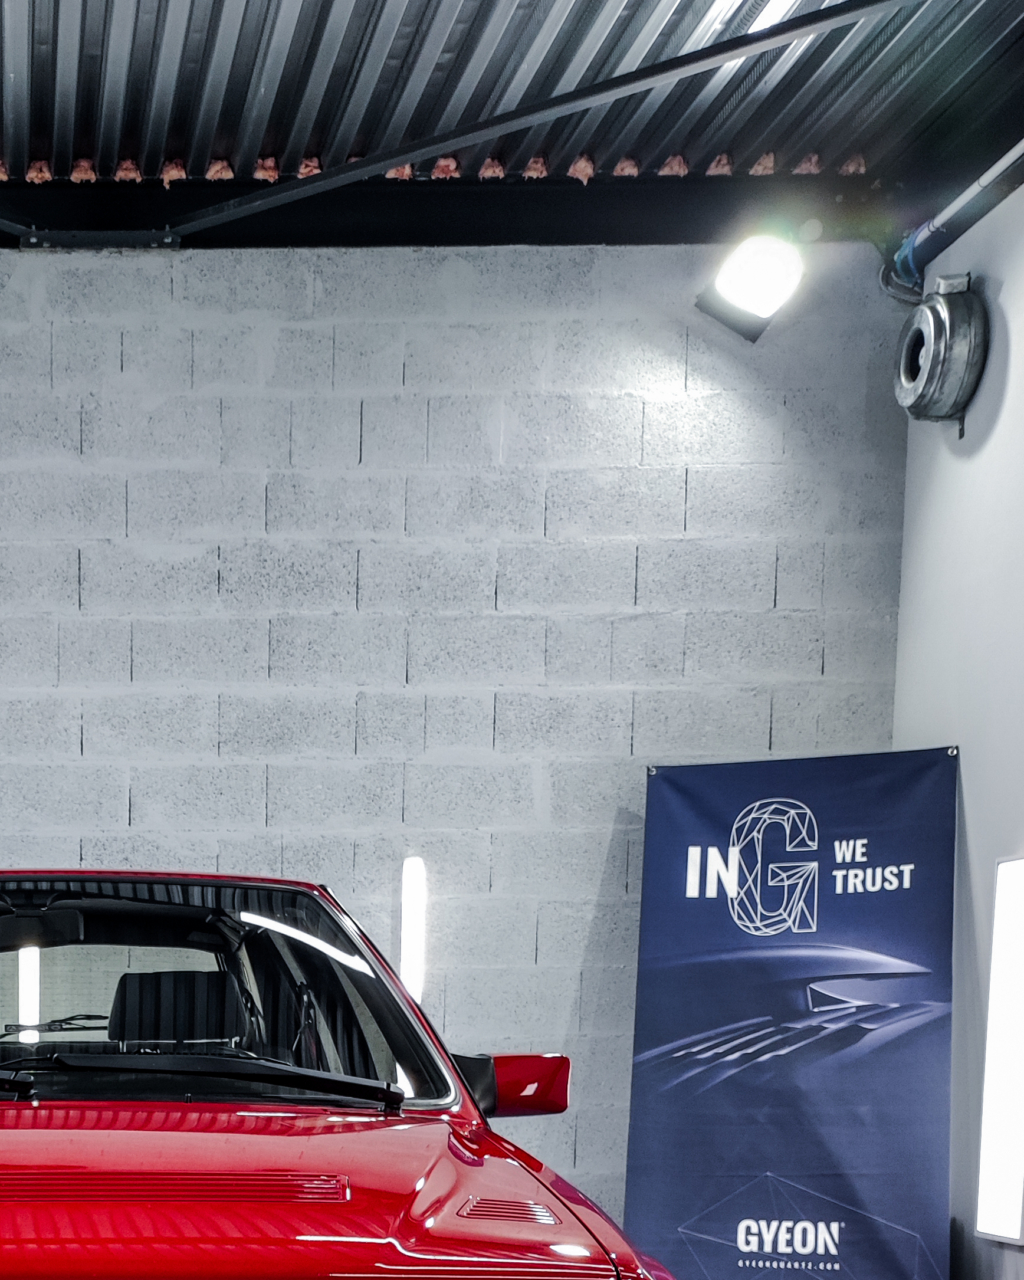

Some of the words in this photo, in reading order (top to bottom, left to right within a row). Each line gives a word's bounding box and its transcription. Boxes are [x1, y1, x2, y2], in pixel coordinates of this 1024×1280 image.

[834, 838, 868, 863] WE
[832, 863, 915, 894] TRUST
[737, 1219, 839, 1255] GYEON
